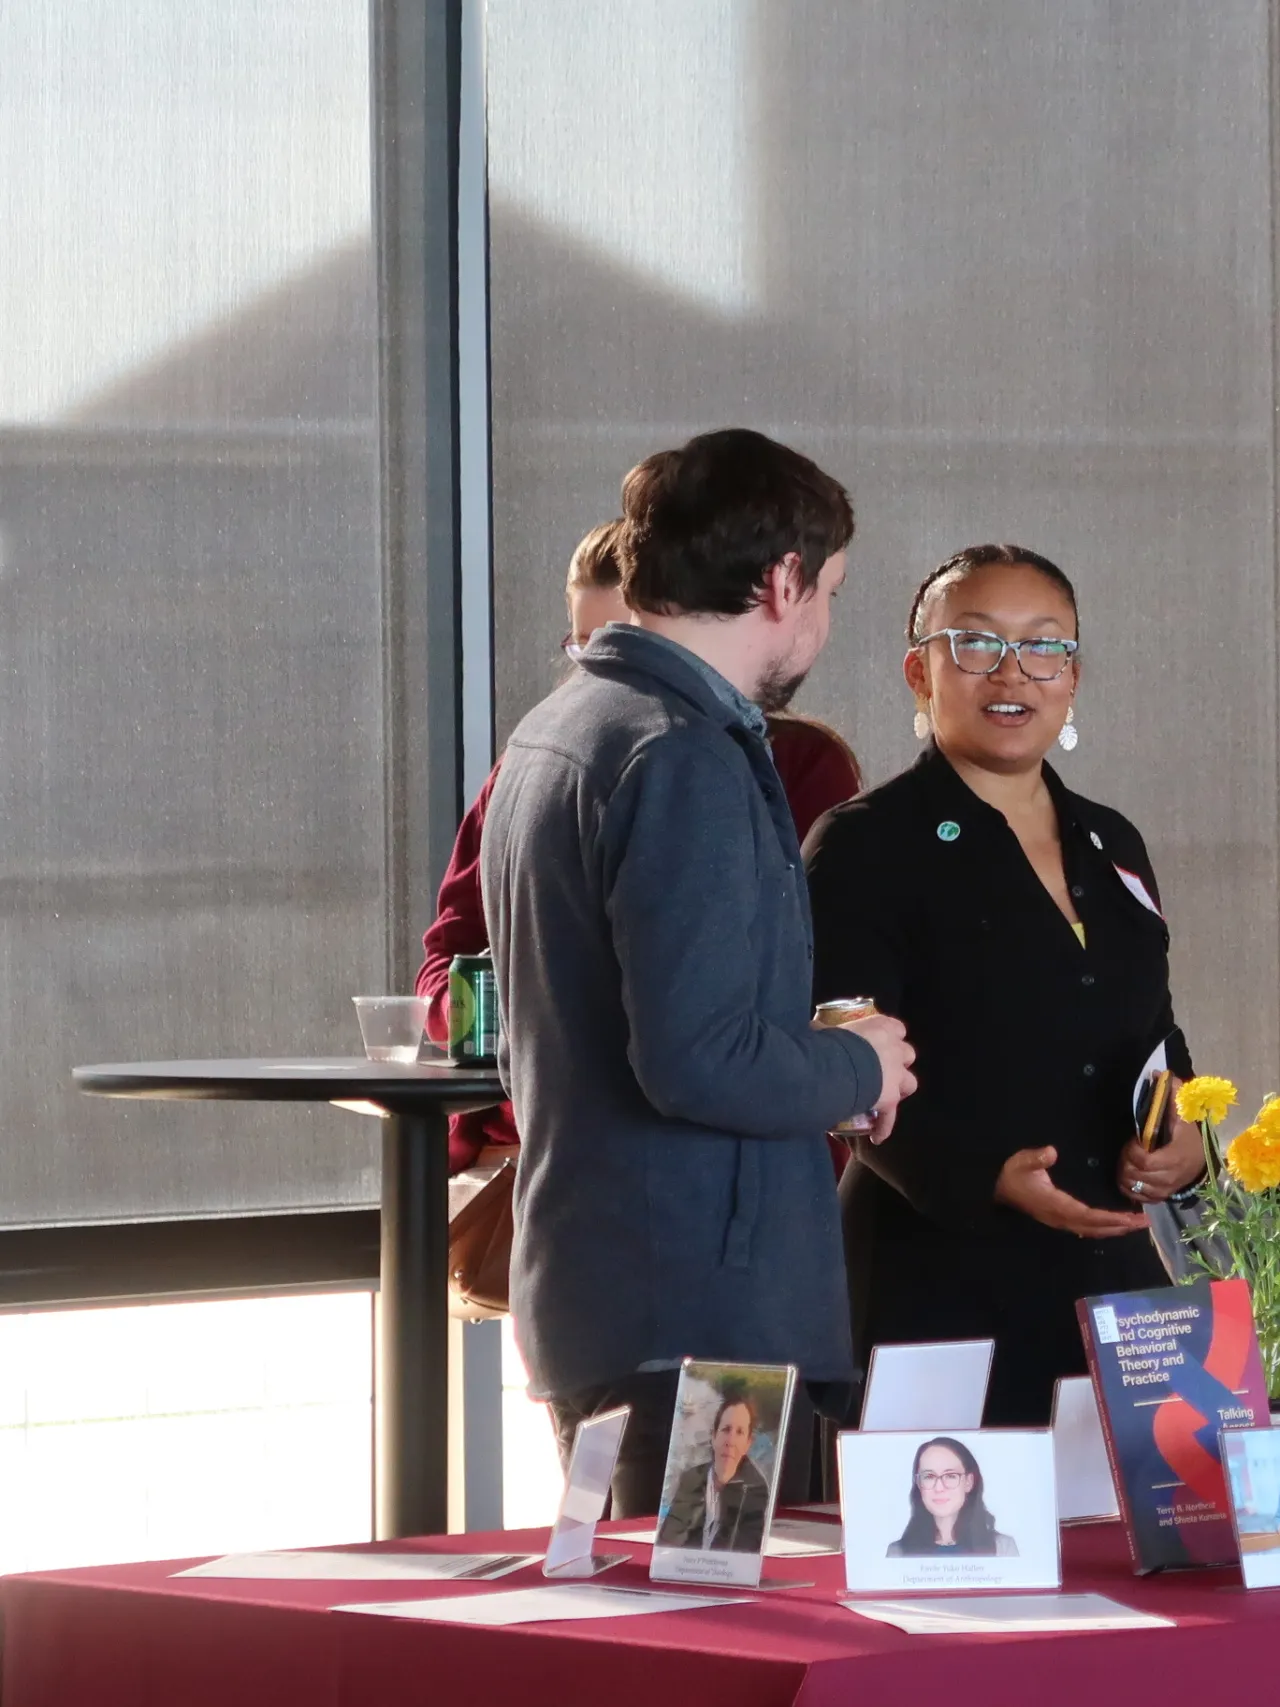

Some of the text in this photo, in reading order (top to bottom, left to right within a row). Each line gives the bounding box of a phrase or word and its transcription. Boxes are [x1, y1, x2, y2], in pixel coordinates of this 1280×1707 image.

[1116, 1306, 1200, 1329] sychodynamic
[1119, 1323, 1192, 1342] nd Cognitive
[1116, 1339, 1177, 1357] Behavioral
[1118, 1353, 1184, 1372] Theory and
[1122, 1371, 1170, 1387] Practice
[1217, 1406, 1254, 1420] Talking
[1156, 1505, 1175, 1515] Terry
[1159, 1517, 1173, 1527] and
